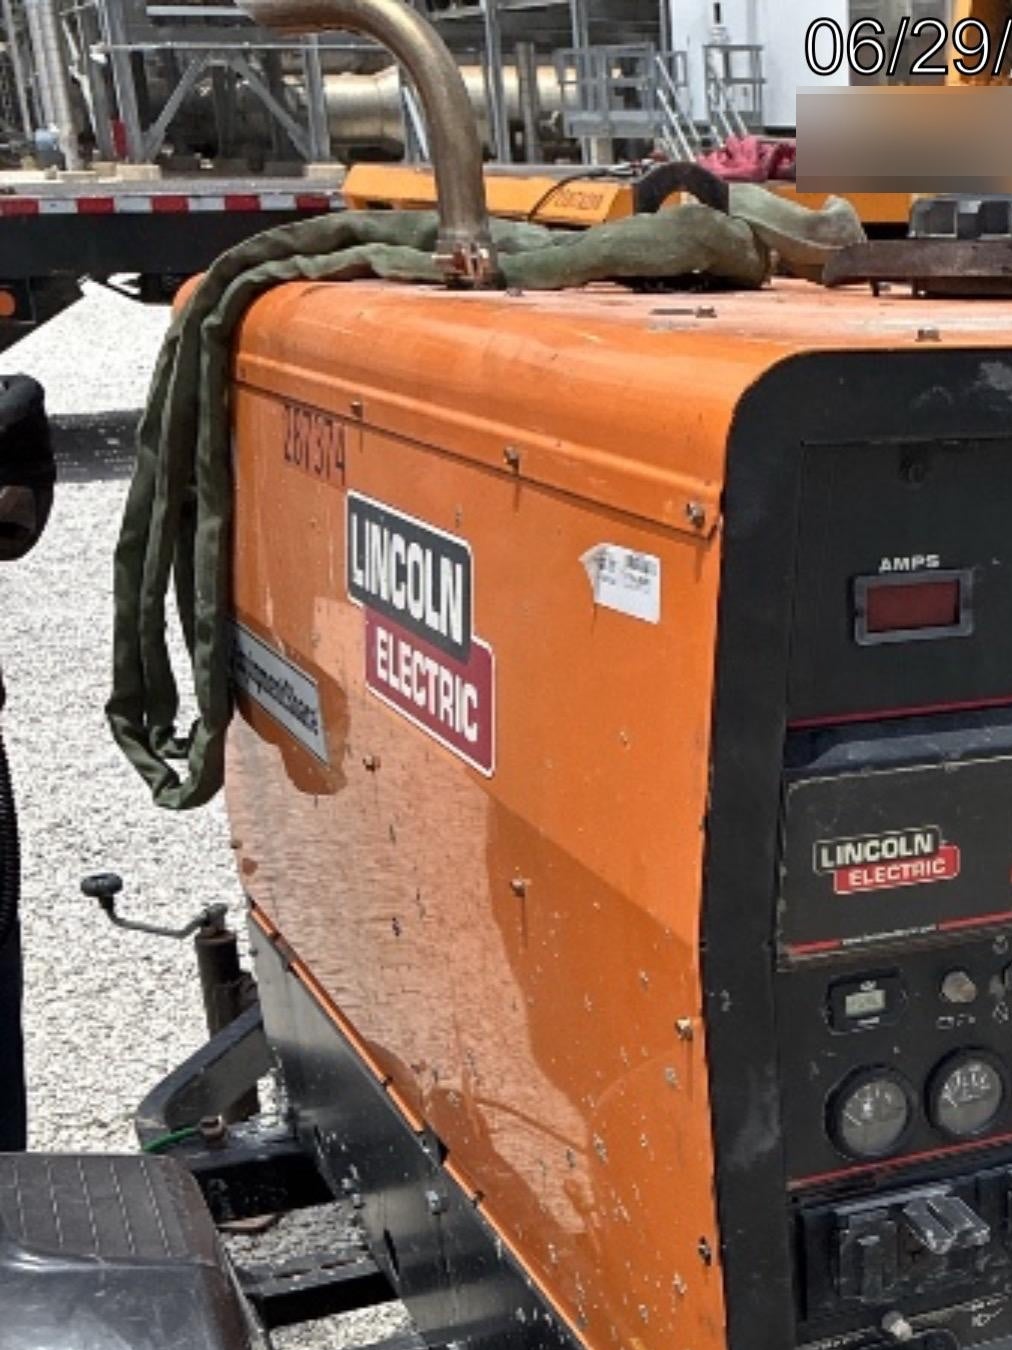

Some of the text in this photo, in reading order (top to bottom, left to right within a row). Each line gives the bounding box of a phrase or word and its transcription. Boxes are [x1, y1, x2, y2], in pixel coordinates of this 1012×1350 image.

[350, 512, 464, 646] LINCOLN
[878, 554, 940, 573] AMPS
[376, 627, 479, 743] ELECTRIC
[820, 832, 934, 868] LINCOLN
[848, 857, 947, 886] ELECTRIC
